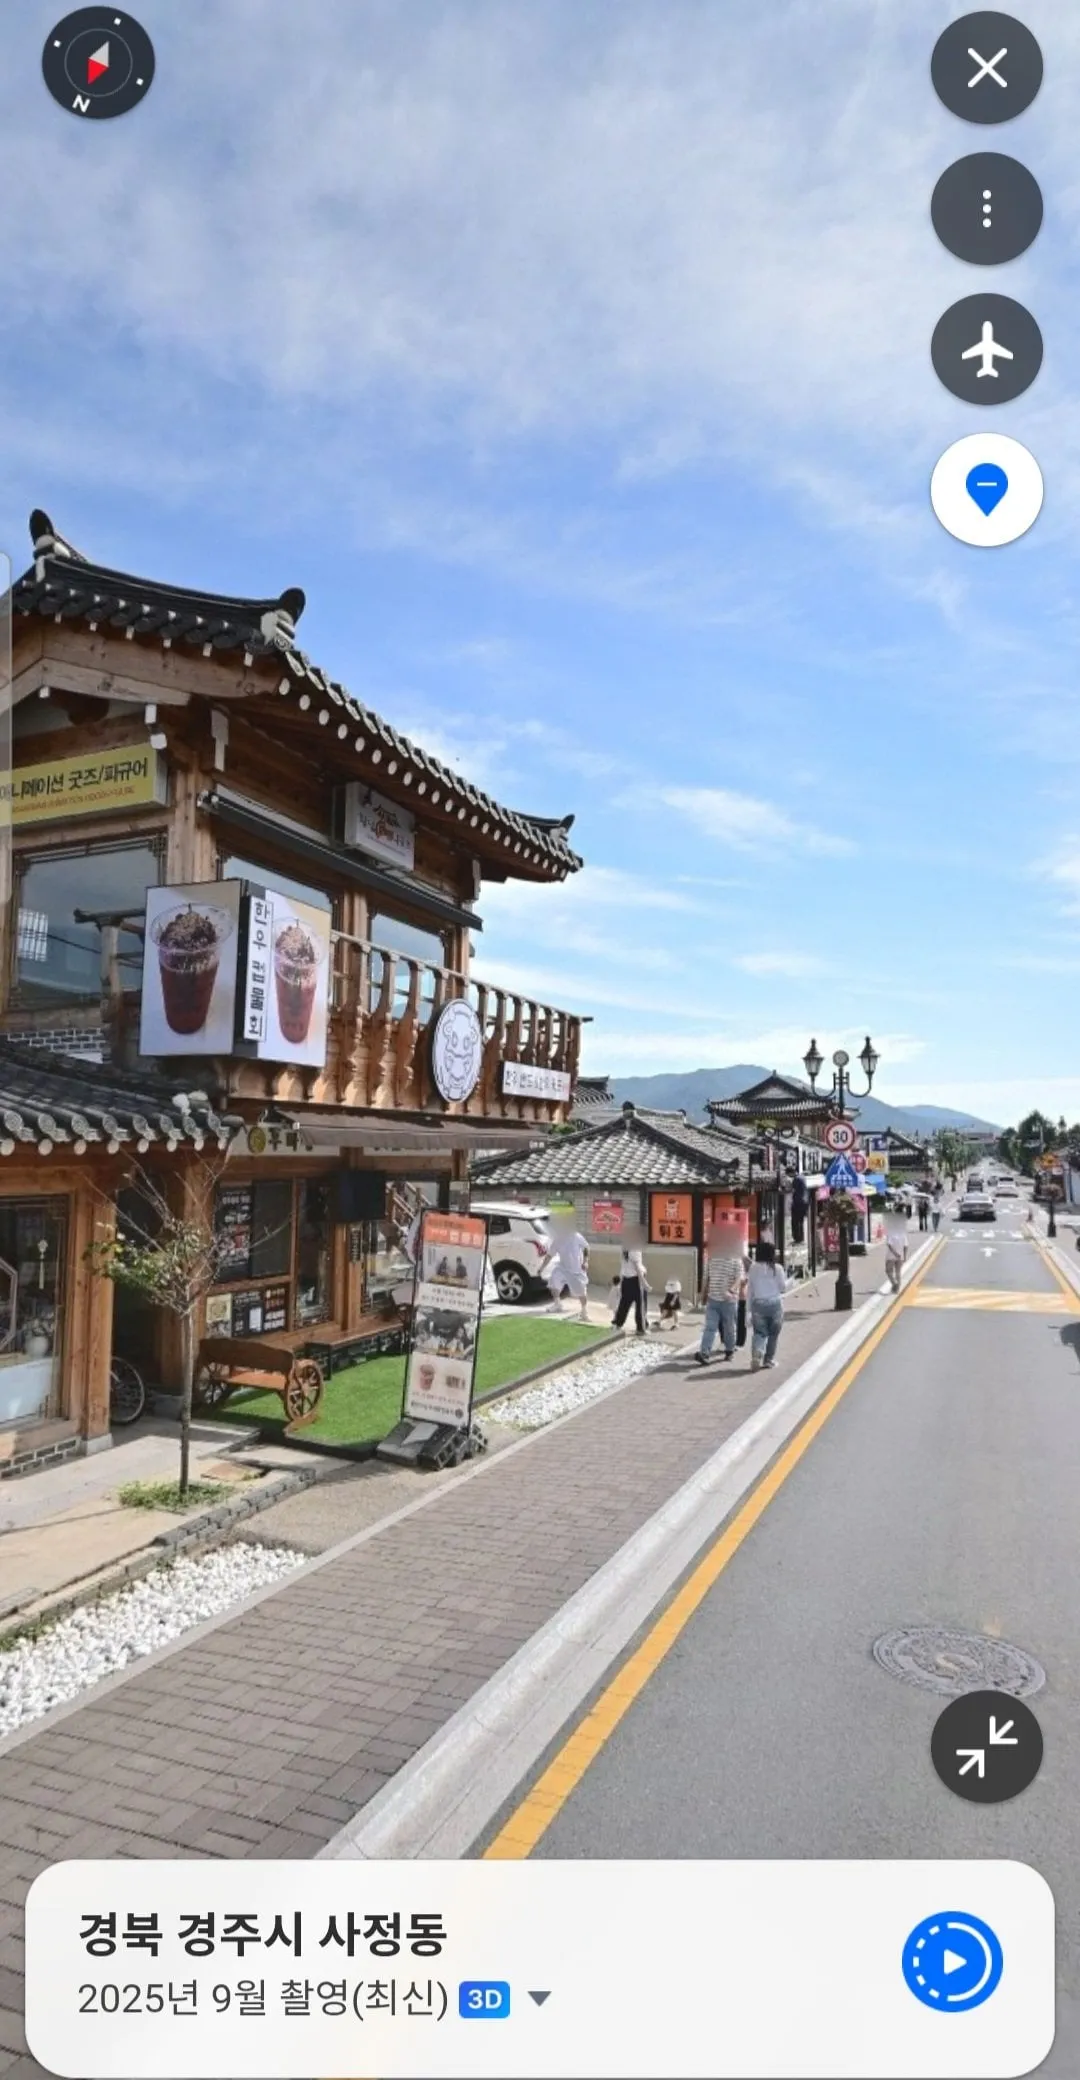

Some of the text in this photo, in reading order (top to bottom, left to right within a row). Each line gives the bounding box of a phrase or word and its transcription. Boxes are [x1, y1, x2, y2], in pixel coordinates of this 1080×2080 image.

[68, 757, 149, 790] 굿즈/피규어
[253, 901, 271, 951] 한우
[832, 1130, 849, 1145] 30
